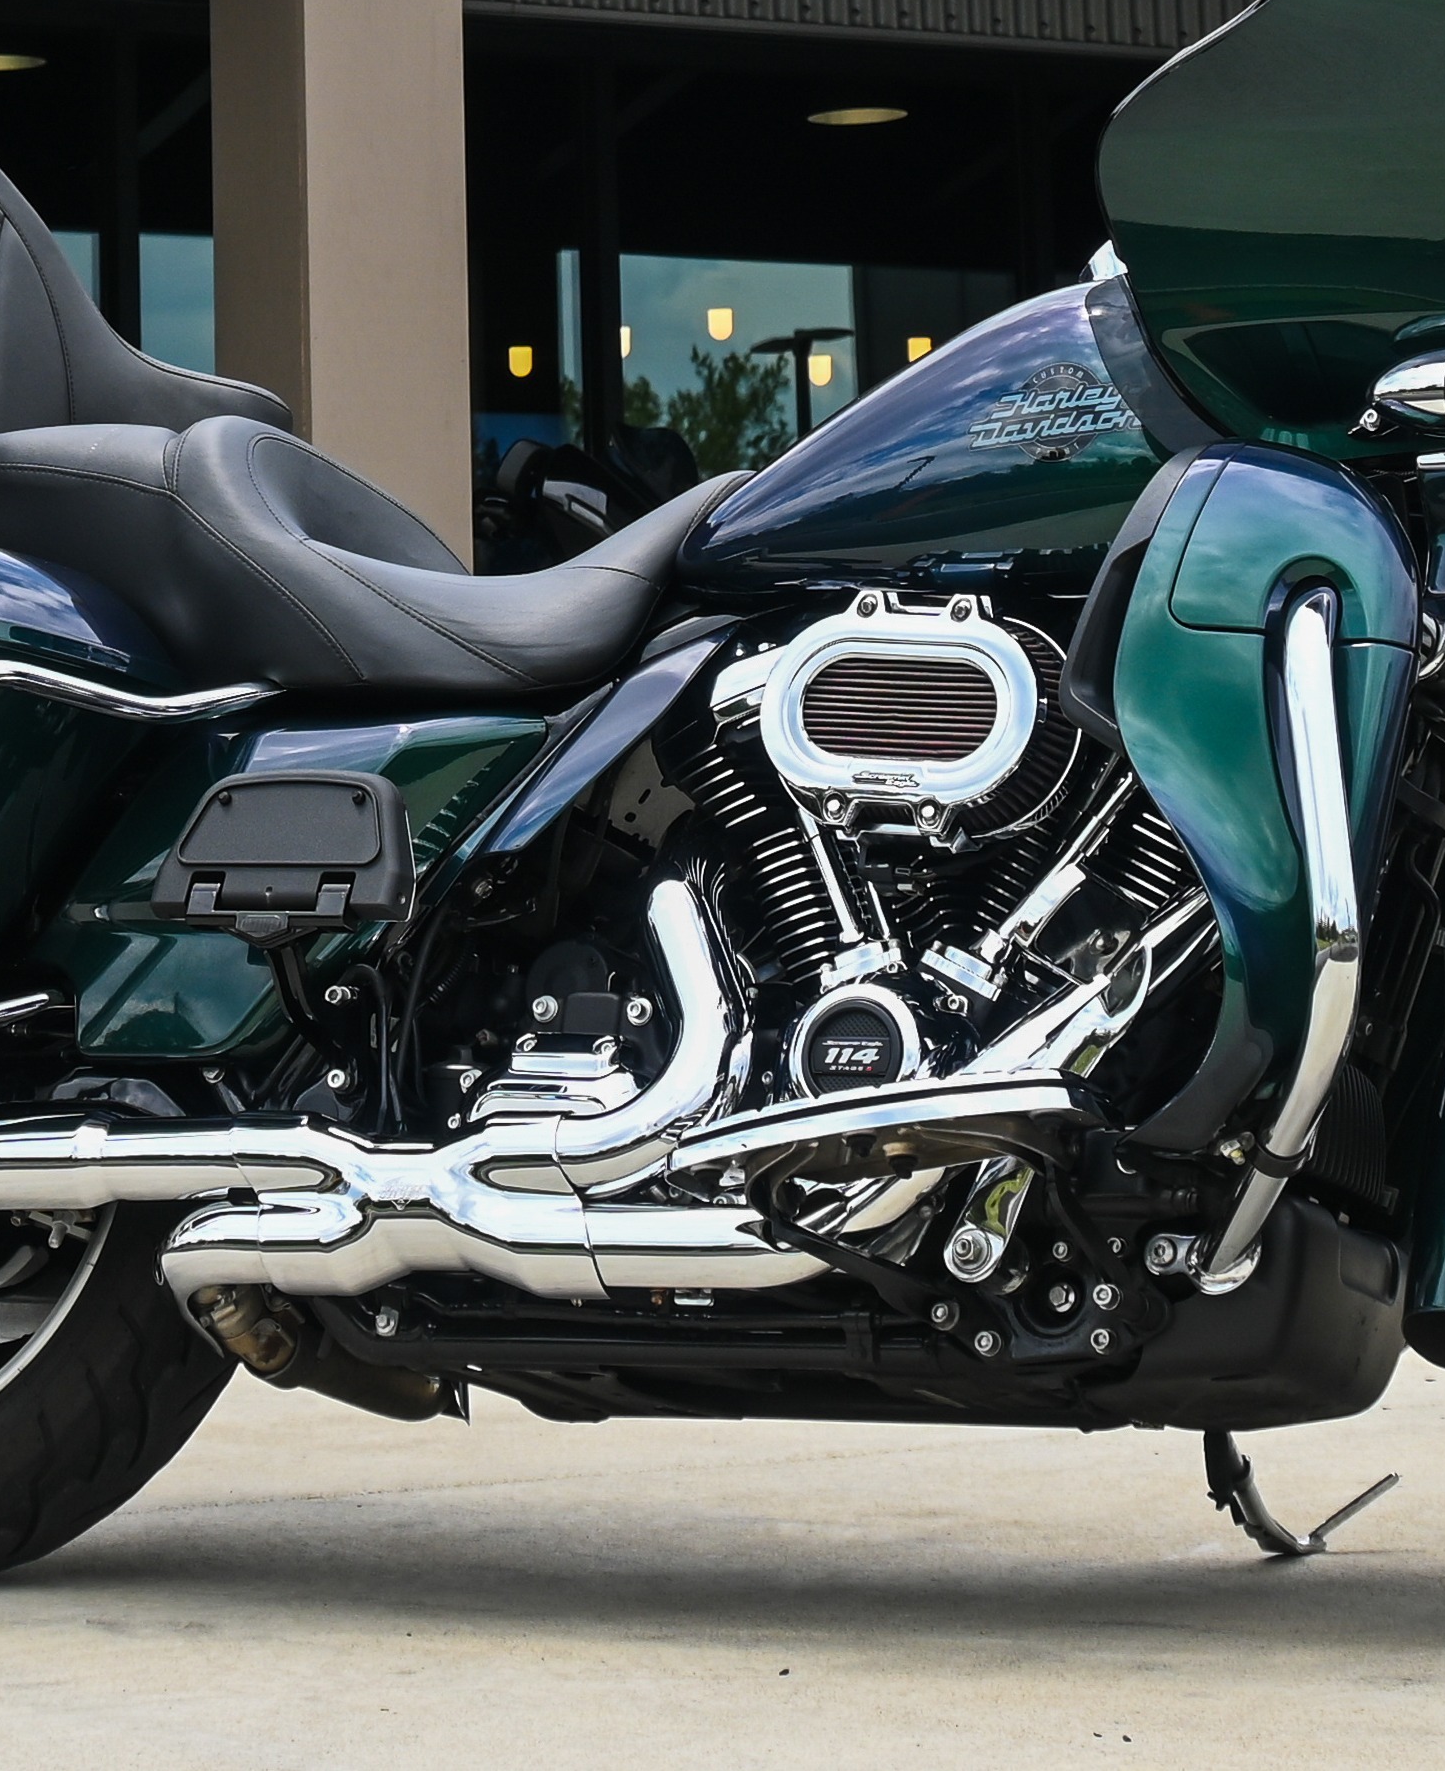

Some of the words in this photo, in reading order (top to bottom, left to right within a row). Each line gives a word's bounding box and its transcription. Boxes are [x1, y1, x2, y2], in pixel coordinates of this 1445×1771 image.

[1032, 366, 1084, 384] CUSTOM
[991, 382, 1122, 419] Harley
[824, 1048, 880, 1064] 114
